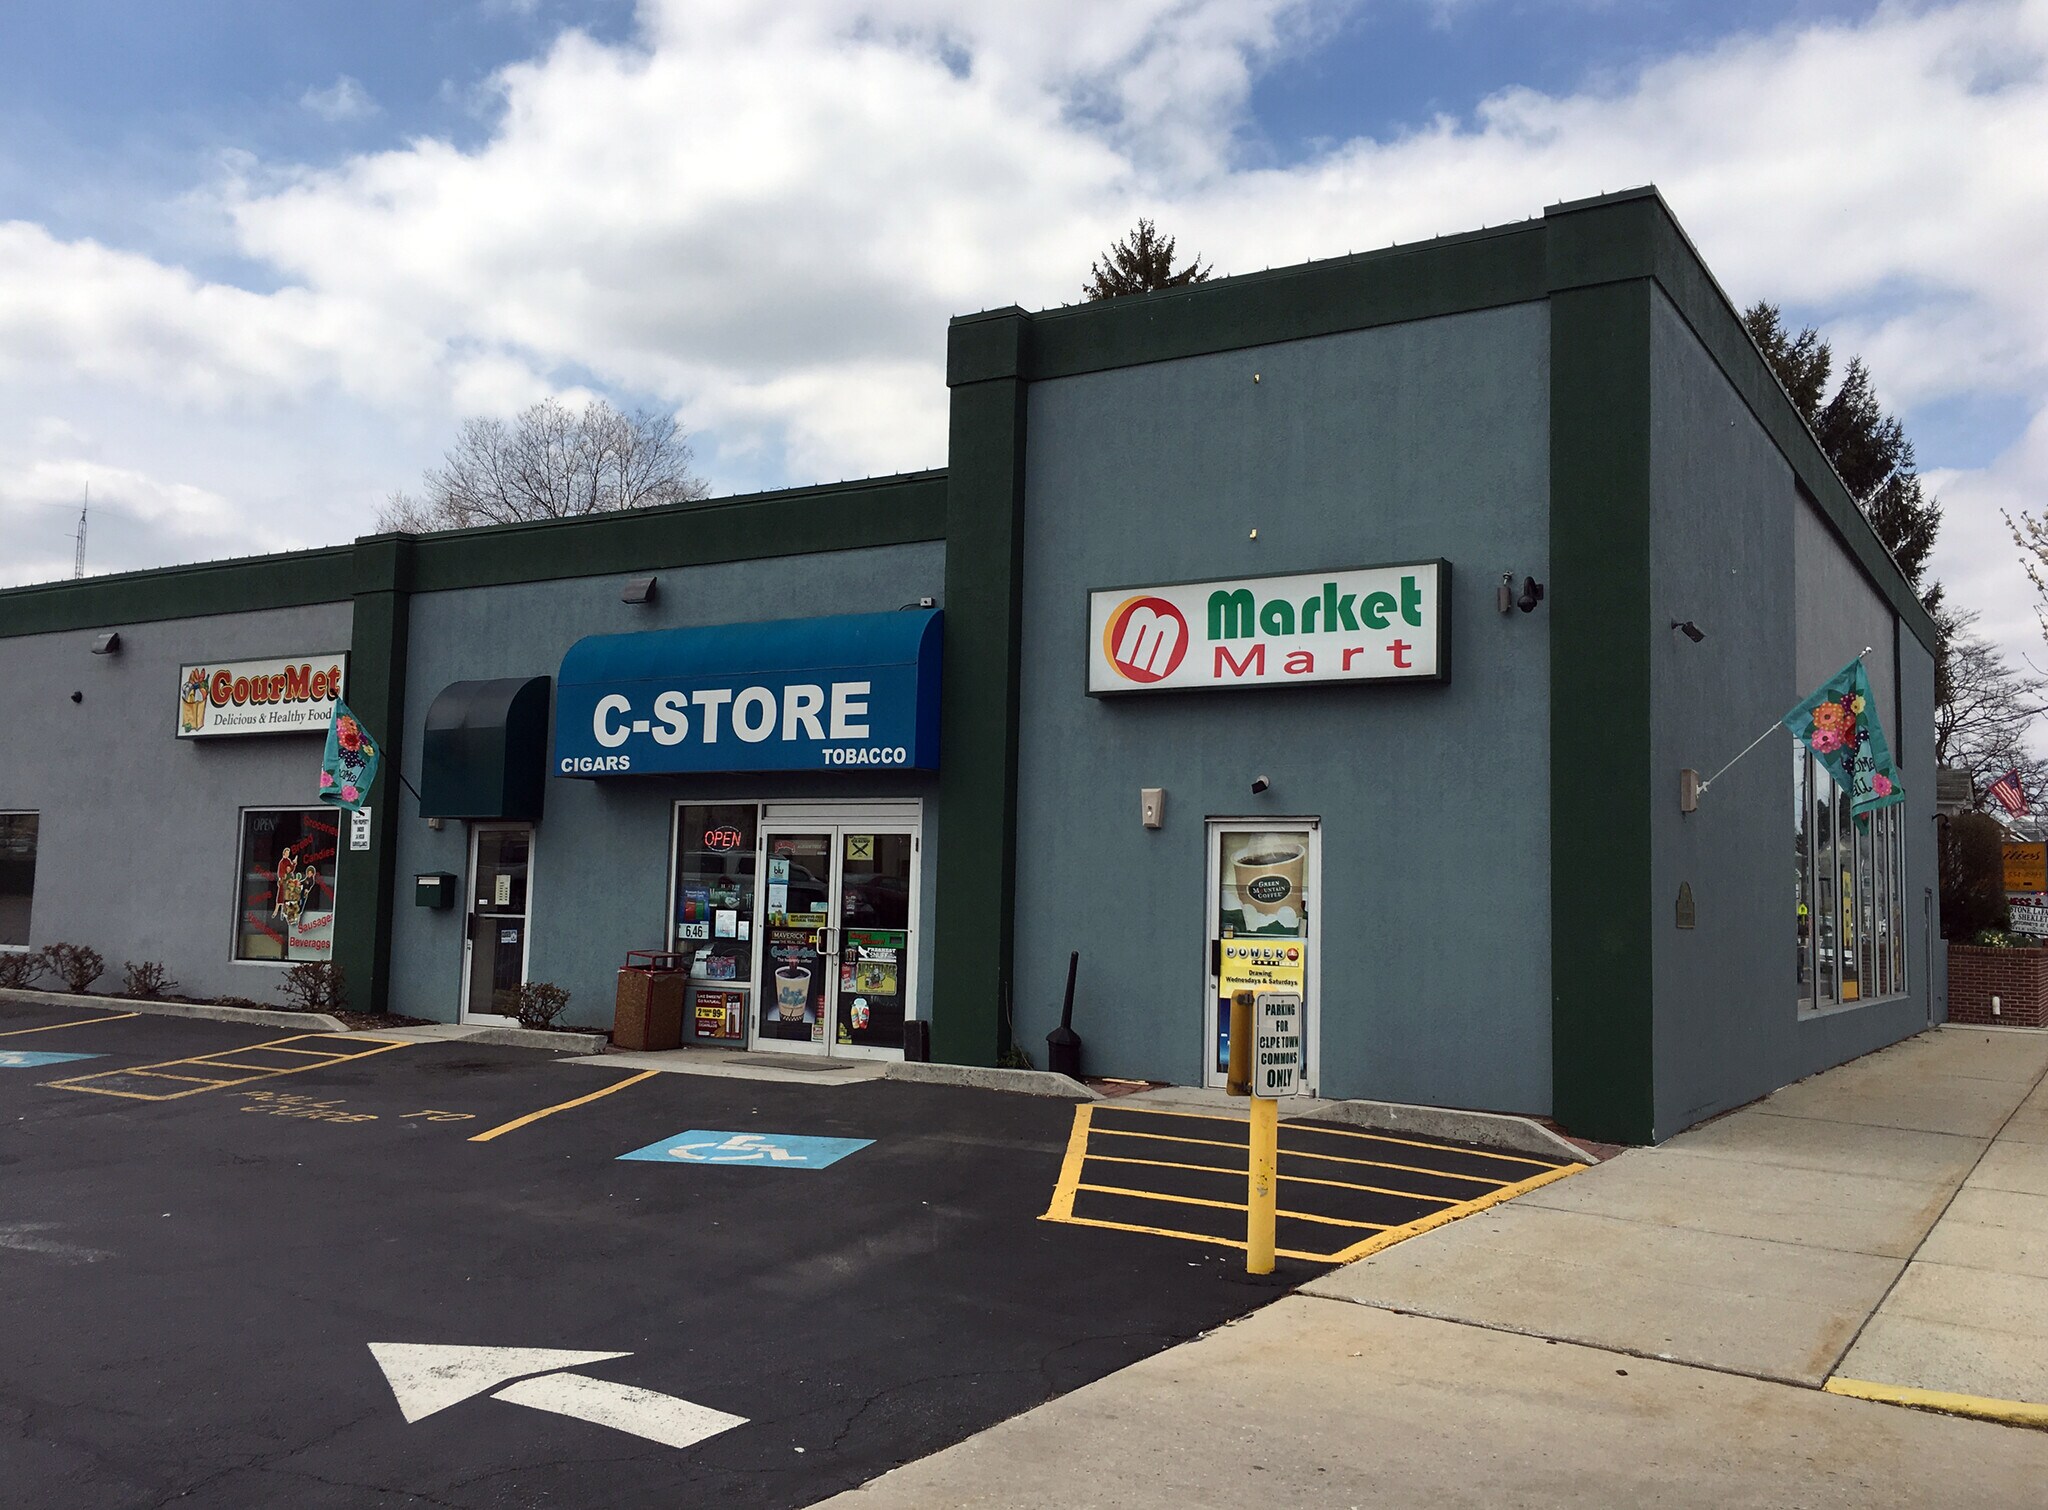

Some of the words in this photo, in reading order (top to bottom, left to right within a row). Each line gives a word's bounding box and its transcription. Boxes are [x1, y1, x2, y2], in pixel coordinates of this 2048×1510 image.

[1207, 576, 1421, 640] Market
[1213, 639, 1412, 678] Mart
[214, 713, 257, 726] Delicious
[258, 713, 266, 723] &
[268, 710, 306, 724] Healthy
[307, 708, 332, 721] Food
[592, 681, 871, 748] C-STORE
[822, 747, 906, 765] TOBACCO
[560, 755, 631, 773] CIGARS
[253, 818, 275, 831] OPEN
[704, 831, 741, 847] OPEN
[302, 846, 336, 865] Candies
[289, 936, 331, 950] Beverages
[773, 932, 805, 940] MAVERICK
[1226, 946, 1285, 960] POWER
[1226, 976, 1261, 985] Wednesdays
[1268, 978, 1298, 987] Saturdays
[1265, 1003, 1295, 1016] PARKING
[1275, 1020, 1289, 1032] FOR
[1281, 1036, 1298, 1048] TOWN
[1261, 1052, 1297, 1065] COMMONS
[1266, 1069, 1293, 1088] ONLY
